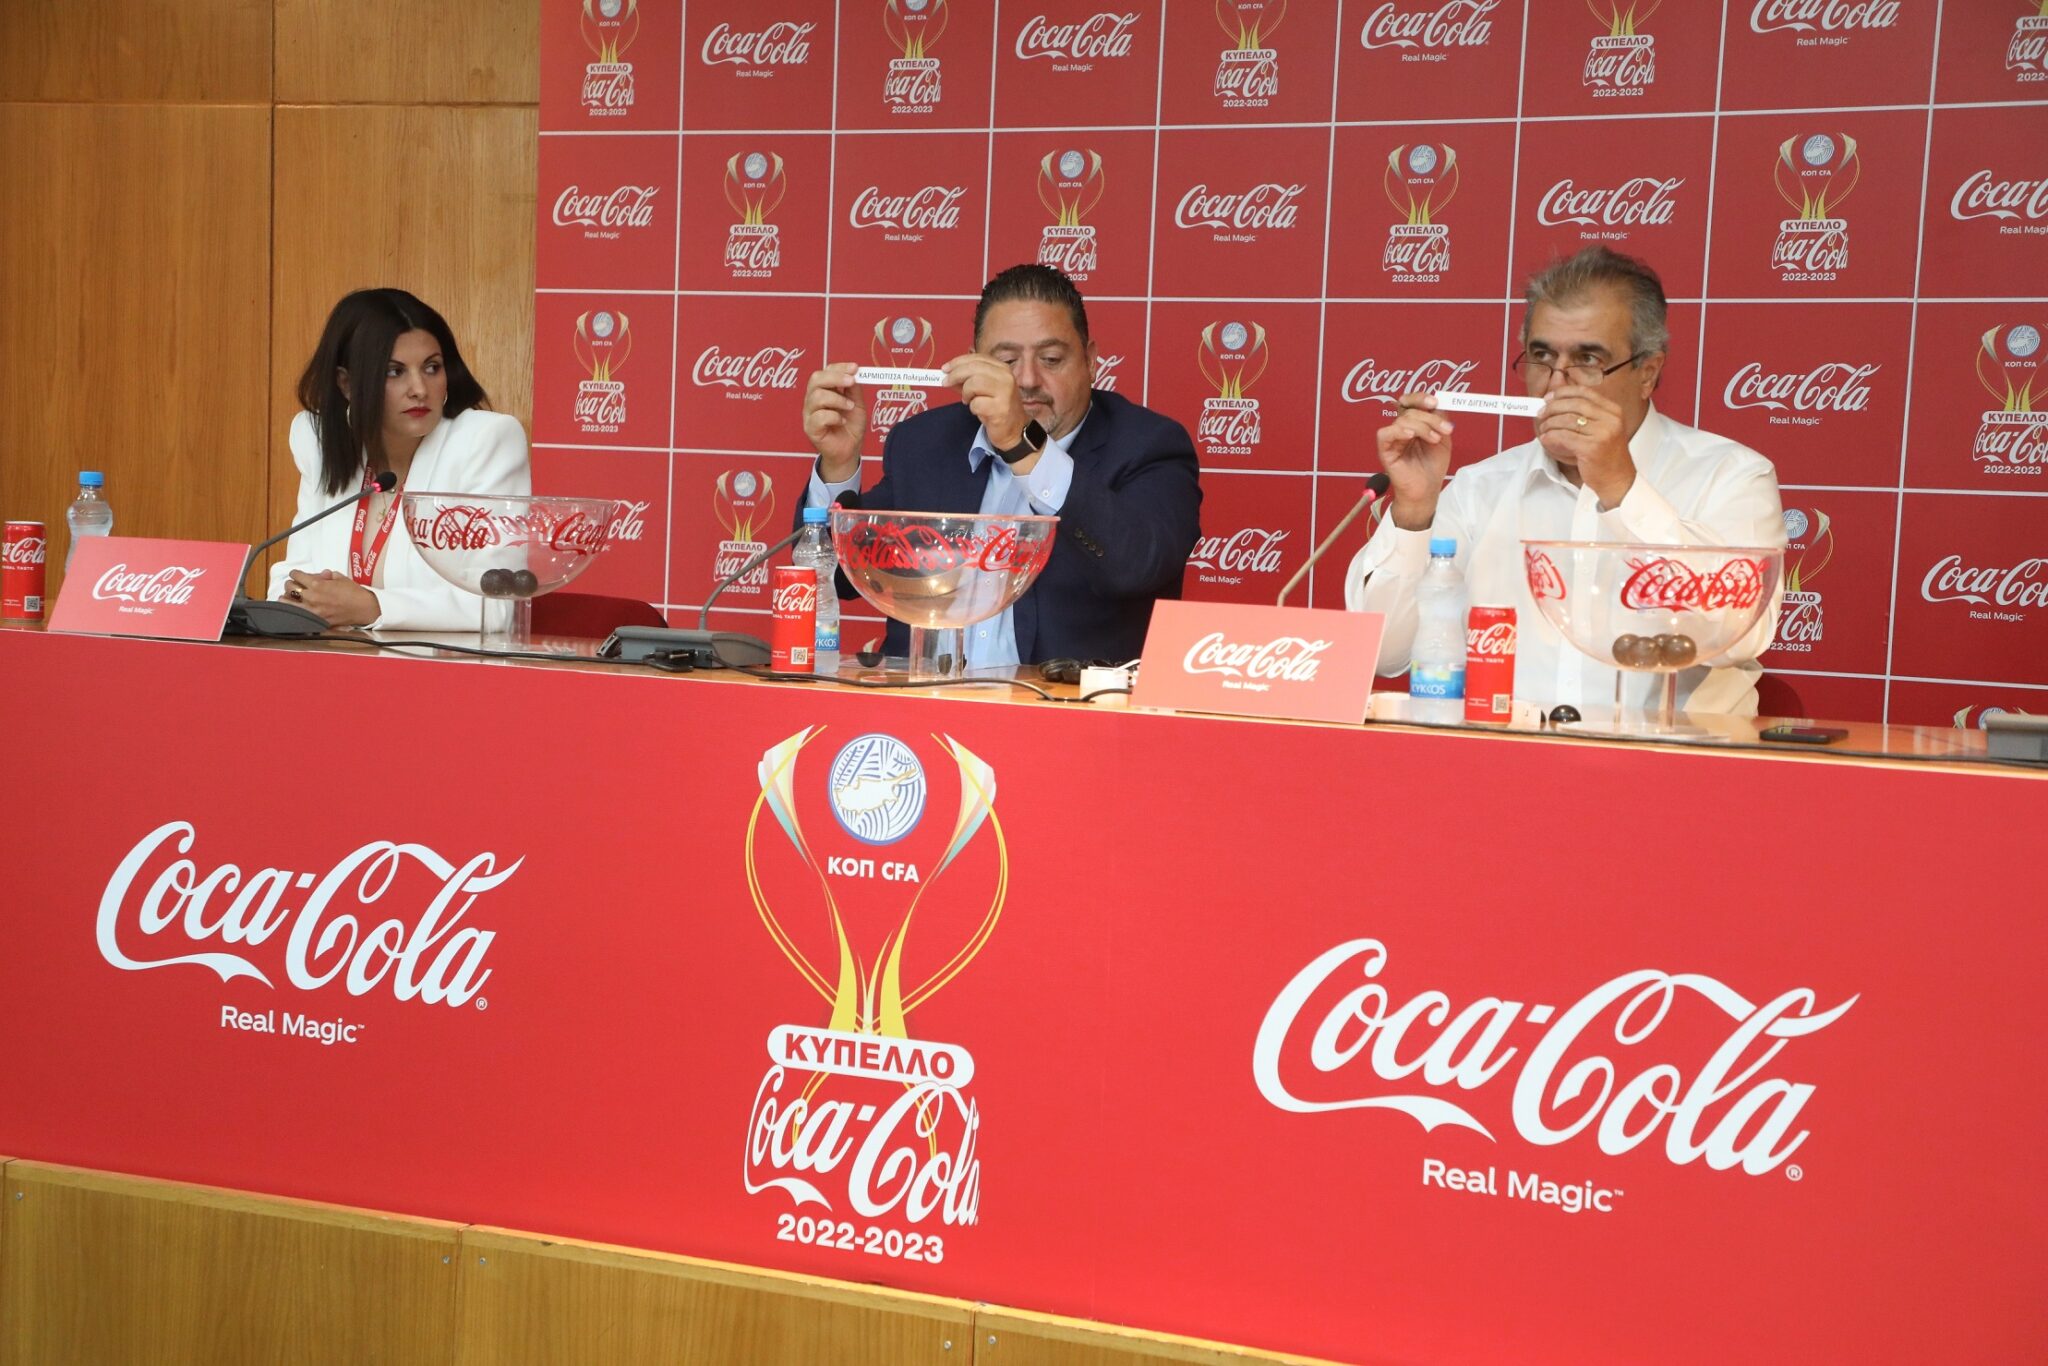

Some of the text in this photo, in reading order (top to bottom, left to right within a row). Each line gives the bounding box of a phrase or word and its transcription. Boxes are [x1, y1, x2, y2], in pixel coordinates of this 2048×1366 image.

[1361, 0, 1499, 49] Coca-Cola
[1016, 13, 1141, 60] Coca-Cola
[1797, 36, 1848, 47] Real Magic
[702, 22, 817, 65] Coca-Cola
[1596, 37, 1649, 48] ΚΥΠΕΛΛΟ
[1225, 50, 1272, 60] ΚΥΠΕΛΛΟ
[1402, 52, 1446, 63] Real Magic
[590, 64, 629, 74] ΚΥΠΕΛΛΟ
[893, 59, 936, 69] ΚΥΠΕΛΛΟ
[1052, 63, 1092, 73] Real Magic
[736, 69, 773, 78] Real Magic
[1592, 88, 1644, 97] 2022-2023
[1223, 99, 1268, 108] 2022-2023
[589, 108, 627, 116] 2022-2023
[892, 105, 933, 114] 2022-2023
[552, 185, 659, 227] Coca-Cola
[1175, 183, 1307, 230] Coca-Cola
[1537, 177, 1686, 226] Coca-Cola
[849, 186, 968, 230] Coca-Cola
[734, 225, 774, 235] ΚΥΠΕΛΛΟ
[1394, 225, 1444, 236] ΚΥΠΕΛΛΟ
[1785, 221, 1841, 231] ΚΥΠΕΛΛΟ
[2000, 226, 2048, 236] Real Magi
[600, 232, 620, 240] Magic
[1047, 227, 1091, 236] ΚΥΠΕΛΛΟ
[1580, 231, 1628, 241] Real Magic
[884, 233, 923, 243] Real Magic
[1213, 234, 1256, 243] Real Magic
[732, 269, 772, 278] 2022-2023
[1392, 274, 1440, 283] 2022-2023
[1782, 272, 1836, 281] 2022-2023
[693, 345, 806, 389] Coca-Cola
[582, 382, 621, 391] ΚΥΠΕΛΛΟ
[1724, 362, 1882, 411] Coca-Cola
[743, 392, 763, 401] Magic
[881, 391, 923, 400] ΚΥΠΕΛΛΟ
[1208, 400, 1254, 409] ΚΥΠΕΛΛΟ
[1769, 416, 1821, 426] Real Magic
[1988, 413, 2047, 423] ΚΥΠΕΛΛΟ
[1206, 446, 1252, 455] 2022-2023
[1984, 465, 2042, 475] 2022-2023
[723, 542, 763, 551] ΚΥΠΕΛΛΟ
[1186, 528, 1291, 572] ca-Cola
[92, 563, 207, 605] Coca-Cola
[1200, 575, 1241, 585] Real Magic
[1783, 593, 1816, 602] ΕΛΛΟ
[119, 605, 154, 615] Real Magic
[1969, 611, 2023, 622] Real Magic
[1771, 643, 1812, 652] 22-2023
[1183, 632, 1334, 682] Coca-Cola
[827, 856, 920, 884] ΚΟΠ CFA
[96, 820, 526, 1010] Coca-Cola
[221, 1005, 358, 1046] Real Magic
[785, 1032, 955, 1081] ΚΥΠΕΛΛΟ
[1253, 938, 1861, 1178] Coca-Cola
[743, 1064, 980, 1226] Coca-Cola
[1422, 1158, 1614, 1214] Real Magic
[776, 1213, 944, 1265] 2022-2023
